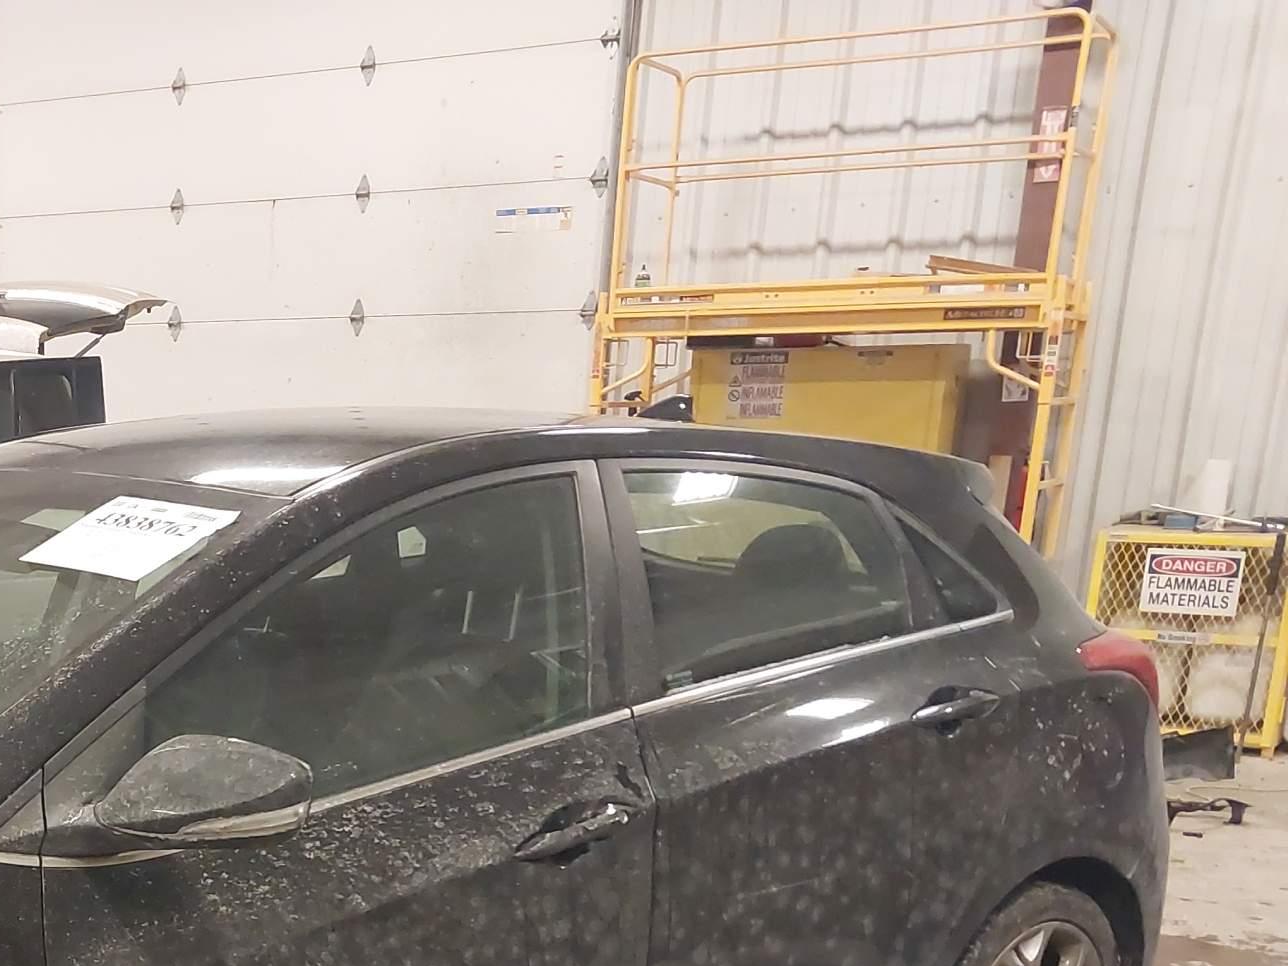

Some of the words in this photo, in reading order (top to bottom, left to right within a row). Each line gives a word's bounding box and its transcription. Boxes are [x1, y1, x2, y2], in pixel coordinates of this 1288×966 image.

[96, 512, 198, 537] 43838762
[1161, 559, 1227, 573] DANGER
[1147, 575, 1236, 593] FLAMMABLE
[1147, 592, 1230, 609] MATERIALS
